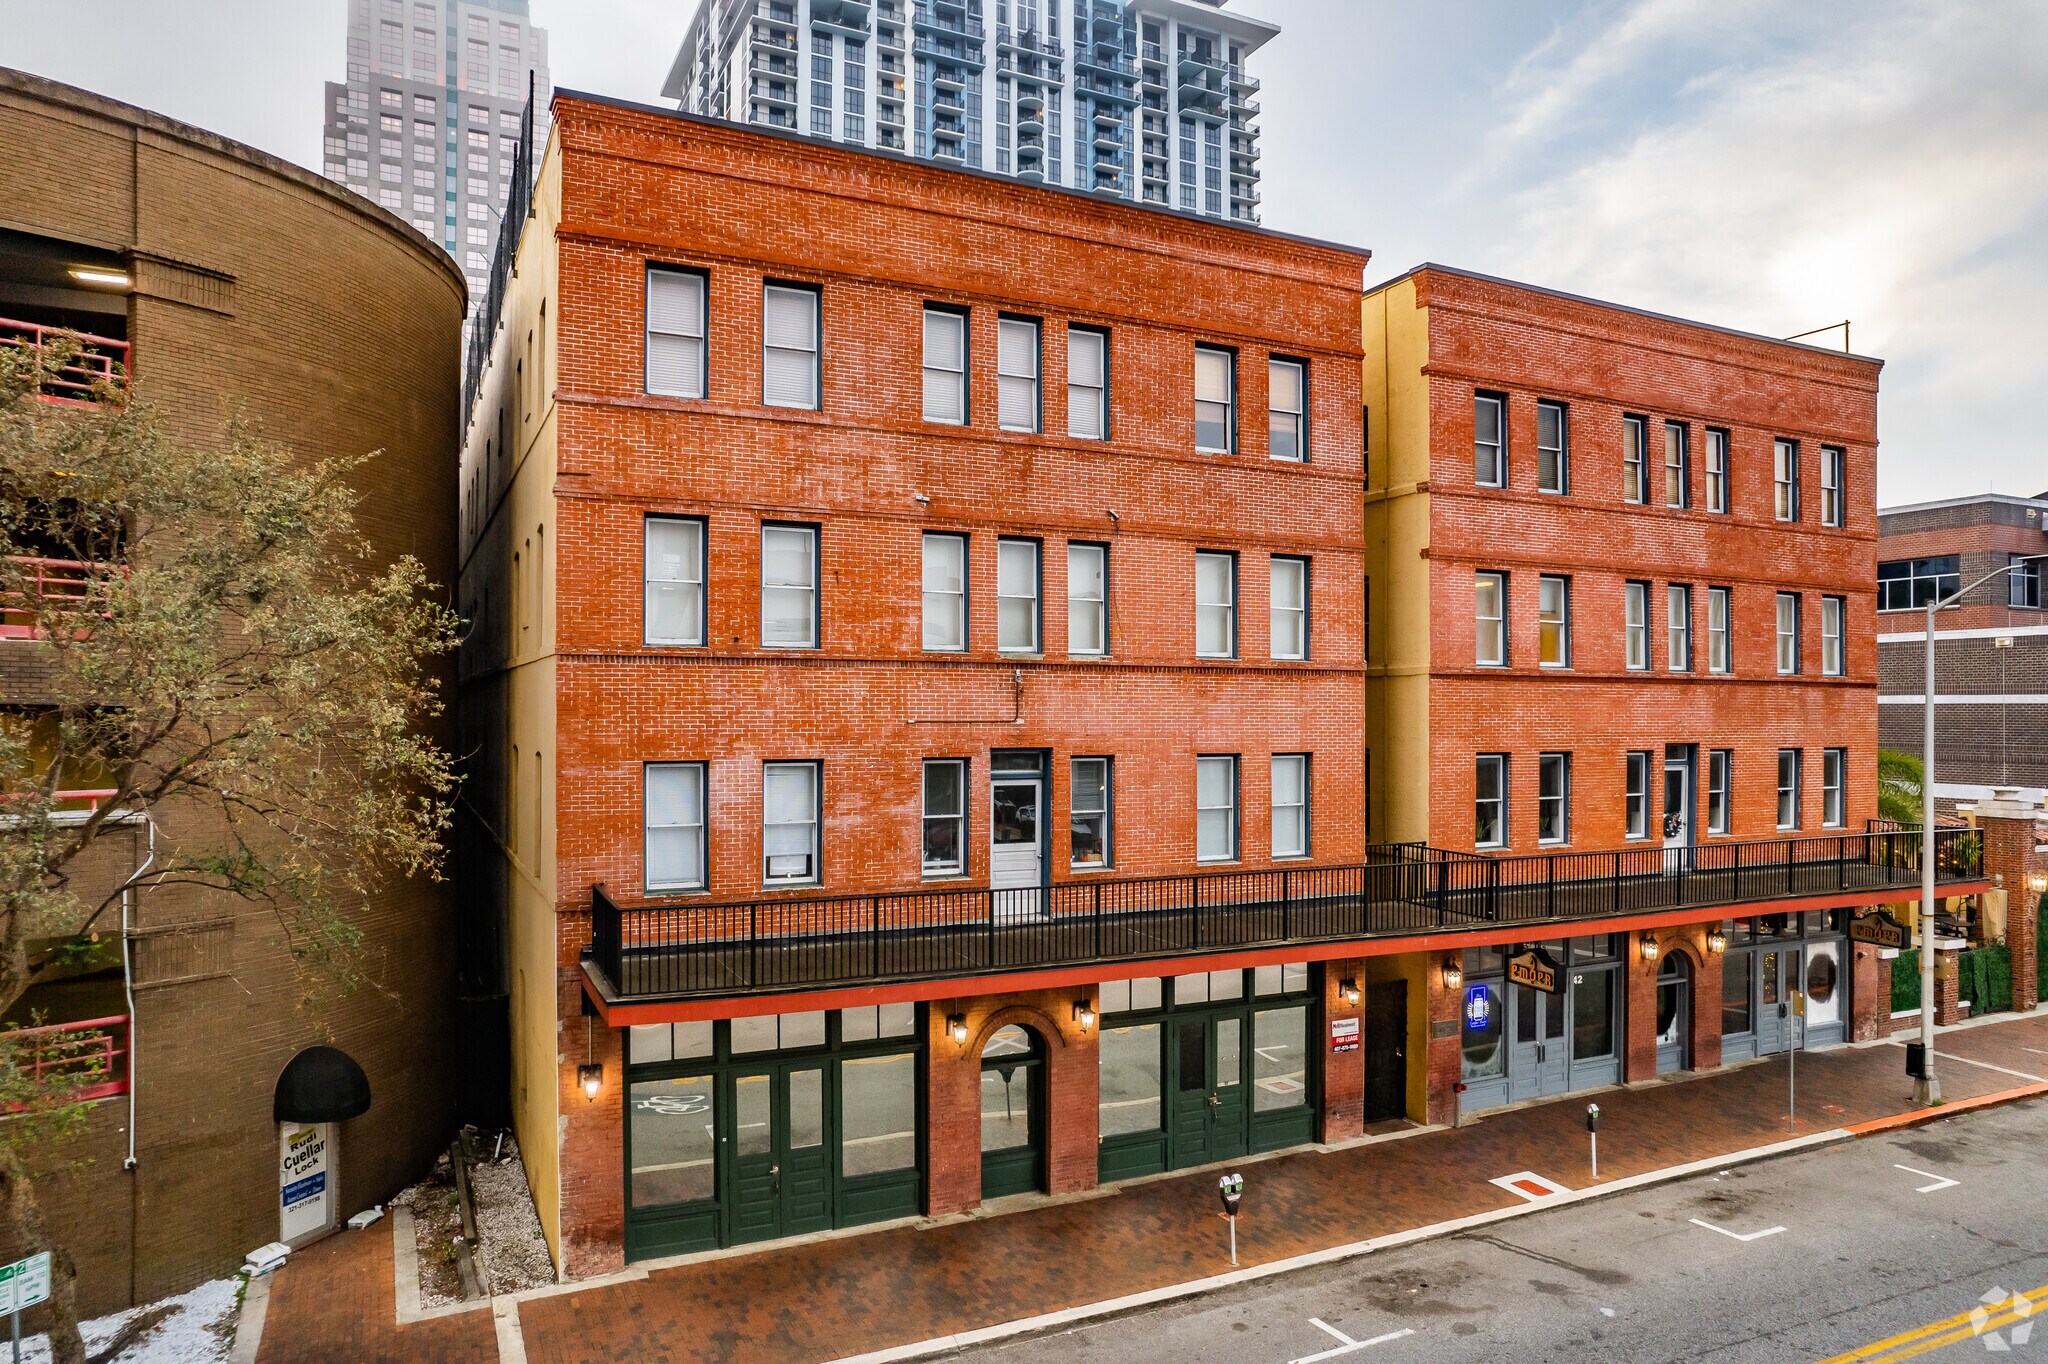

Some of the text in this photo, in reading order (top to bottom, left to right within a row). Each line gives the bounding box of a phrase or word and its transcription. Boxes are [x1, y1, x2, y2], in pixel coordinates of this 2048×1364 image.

[290, 1132, 317, 1152] Rudi
[284, 1140, 326, 1170] Cuellar
[295, 1157, 319, 1175] Lock
[19, 1263, 25, 1274] 2
